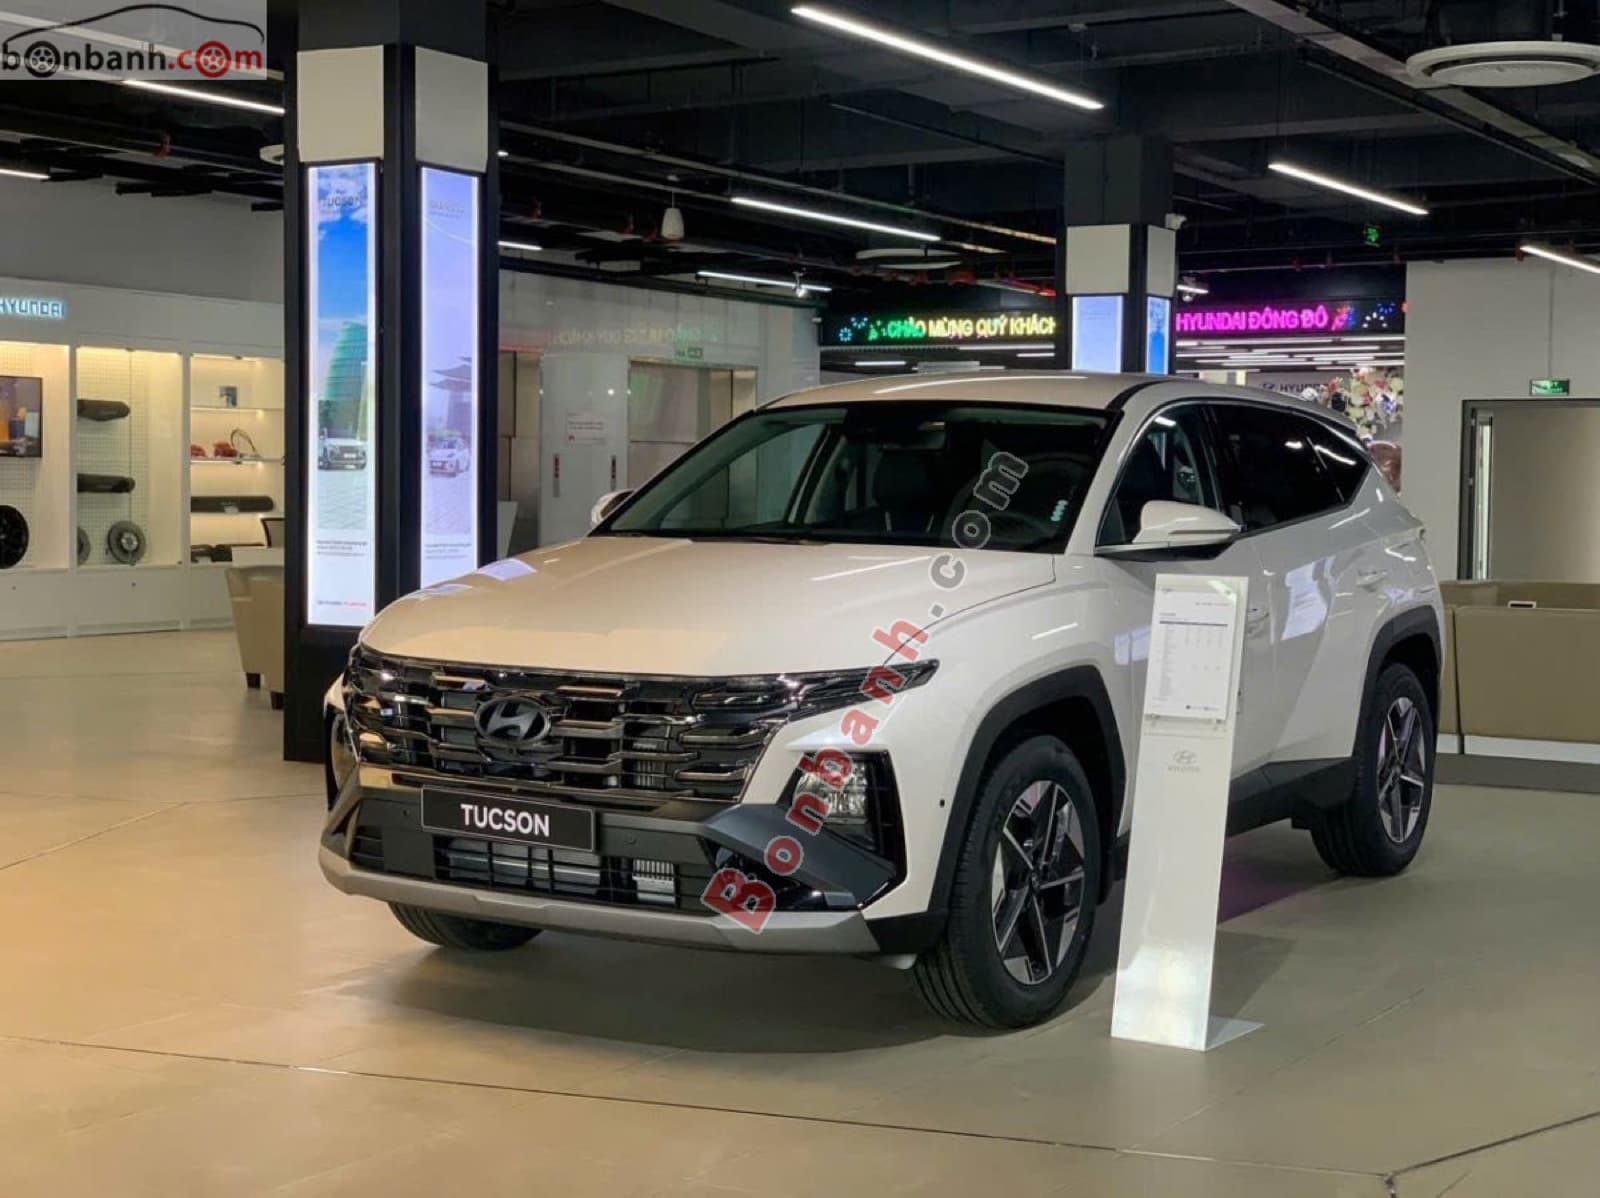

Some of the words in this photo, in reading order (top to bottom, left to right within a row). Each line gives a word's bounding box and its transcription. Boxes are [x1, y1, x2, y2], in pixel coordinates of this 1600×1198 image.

[887, 316, 926, 338] CHÀO
[976, 313, 1007, 338] QUÝ
[1176, 311, 1246, 332] HYUNDAI
[1248, 306, 1298, 331] ĐÔNG
[1300, 304, 1330, 329] ĐÔ
[460, 803, 550, 837] TUCSON
